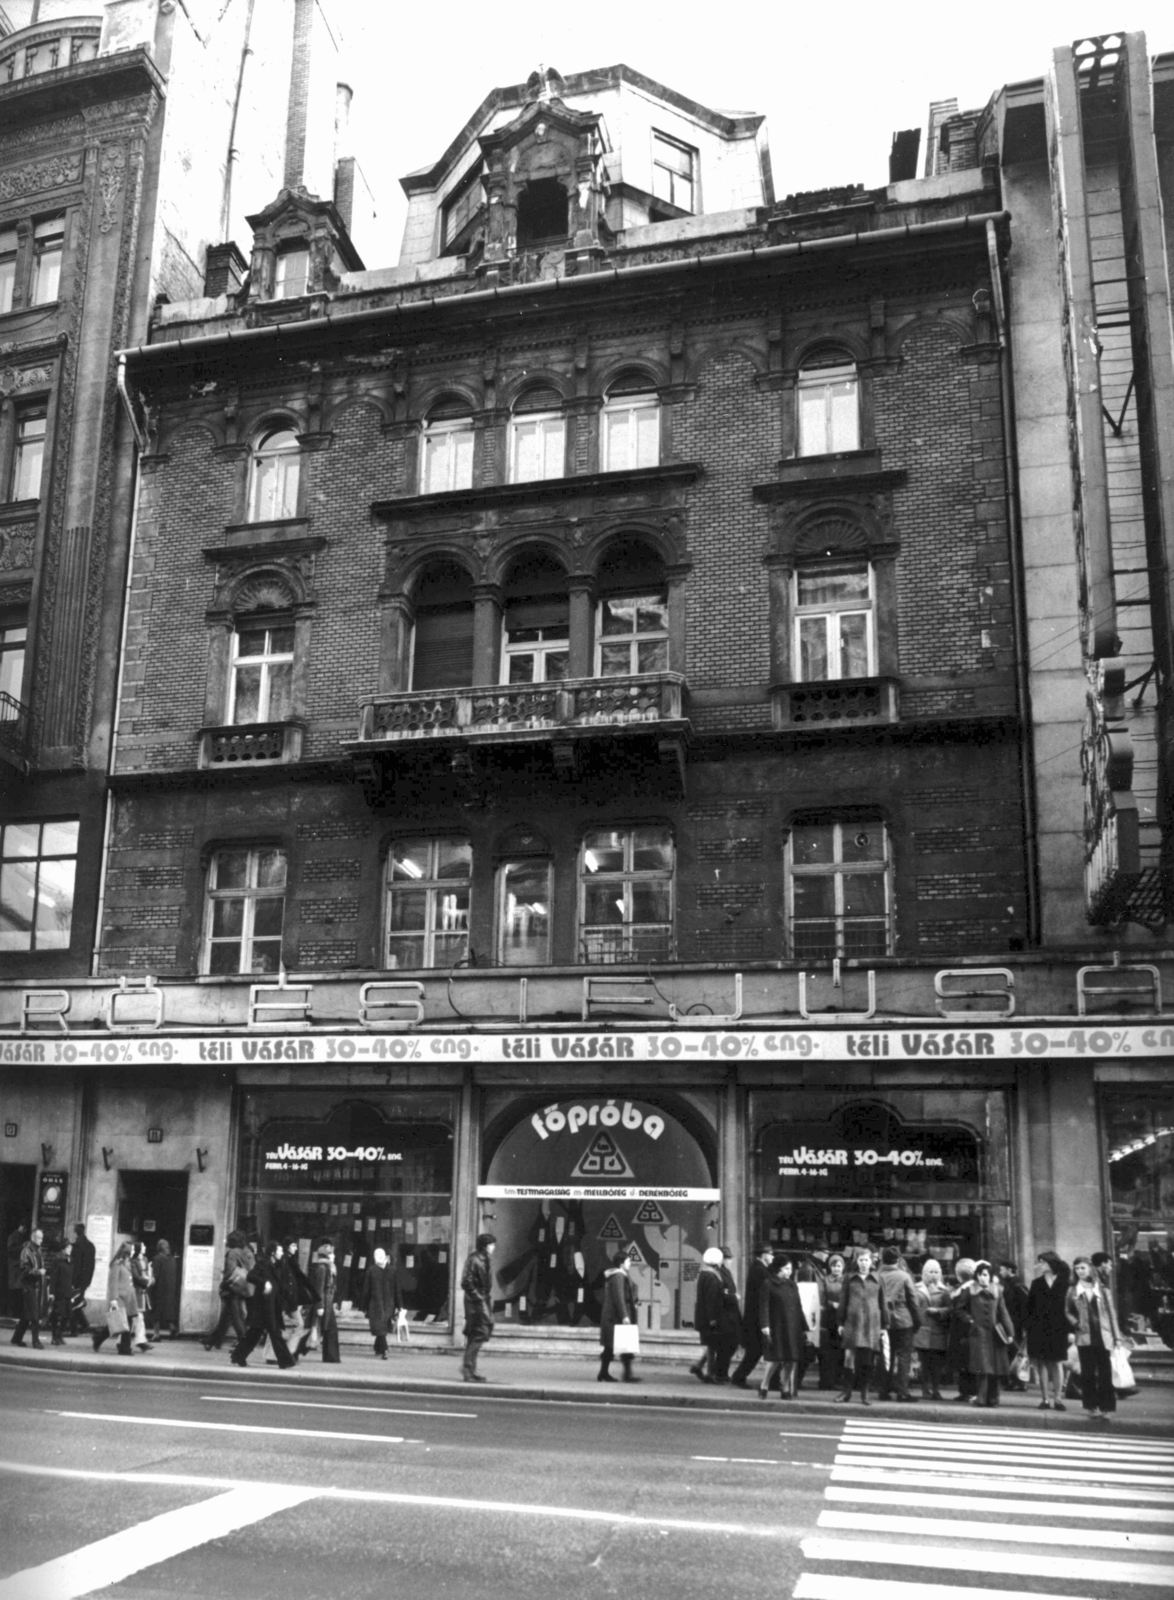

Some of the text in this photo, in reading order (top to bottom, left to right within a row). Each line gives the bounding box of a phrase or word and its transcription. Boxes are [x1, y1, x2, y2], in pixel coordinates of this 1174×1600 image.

[199, 1040, 233, 1061] téli
[502, 1037, 541, 1059] téli
[846, 1033, 891, 1057] téli
[530, 1099, 665, 1140] főpróba
